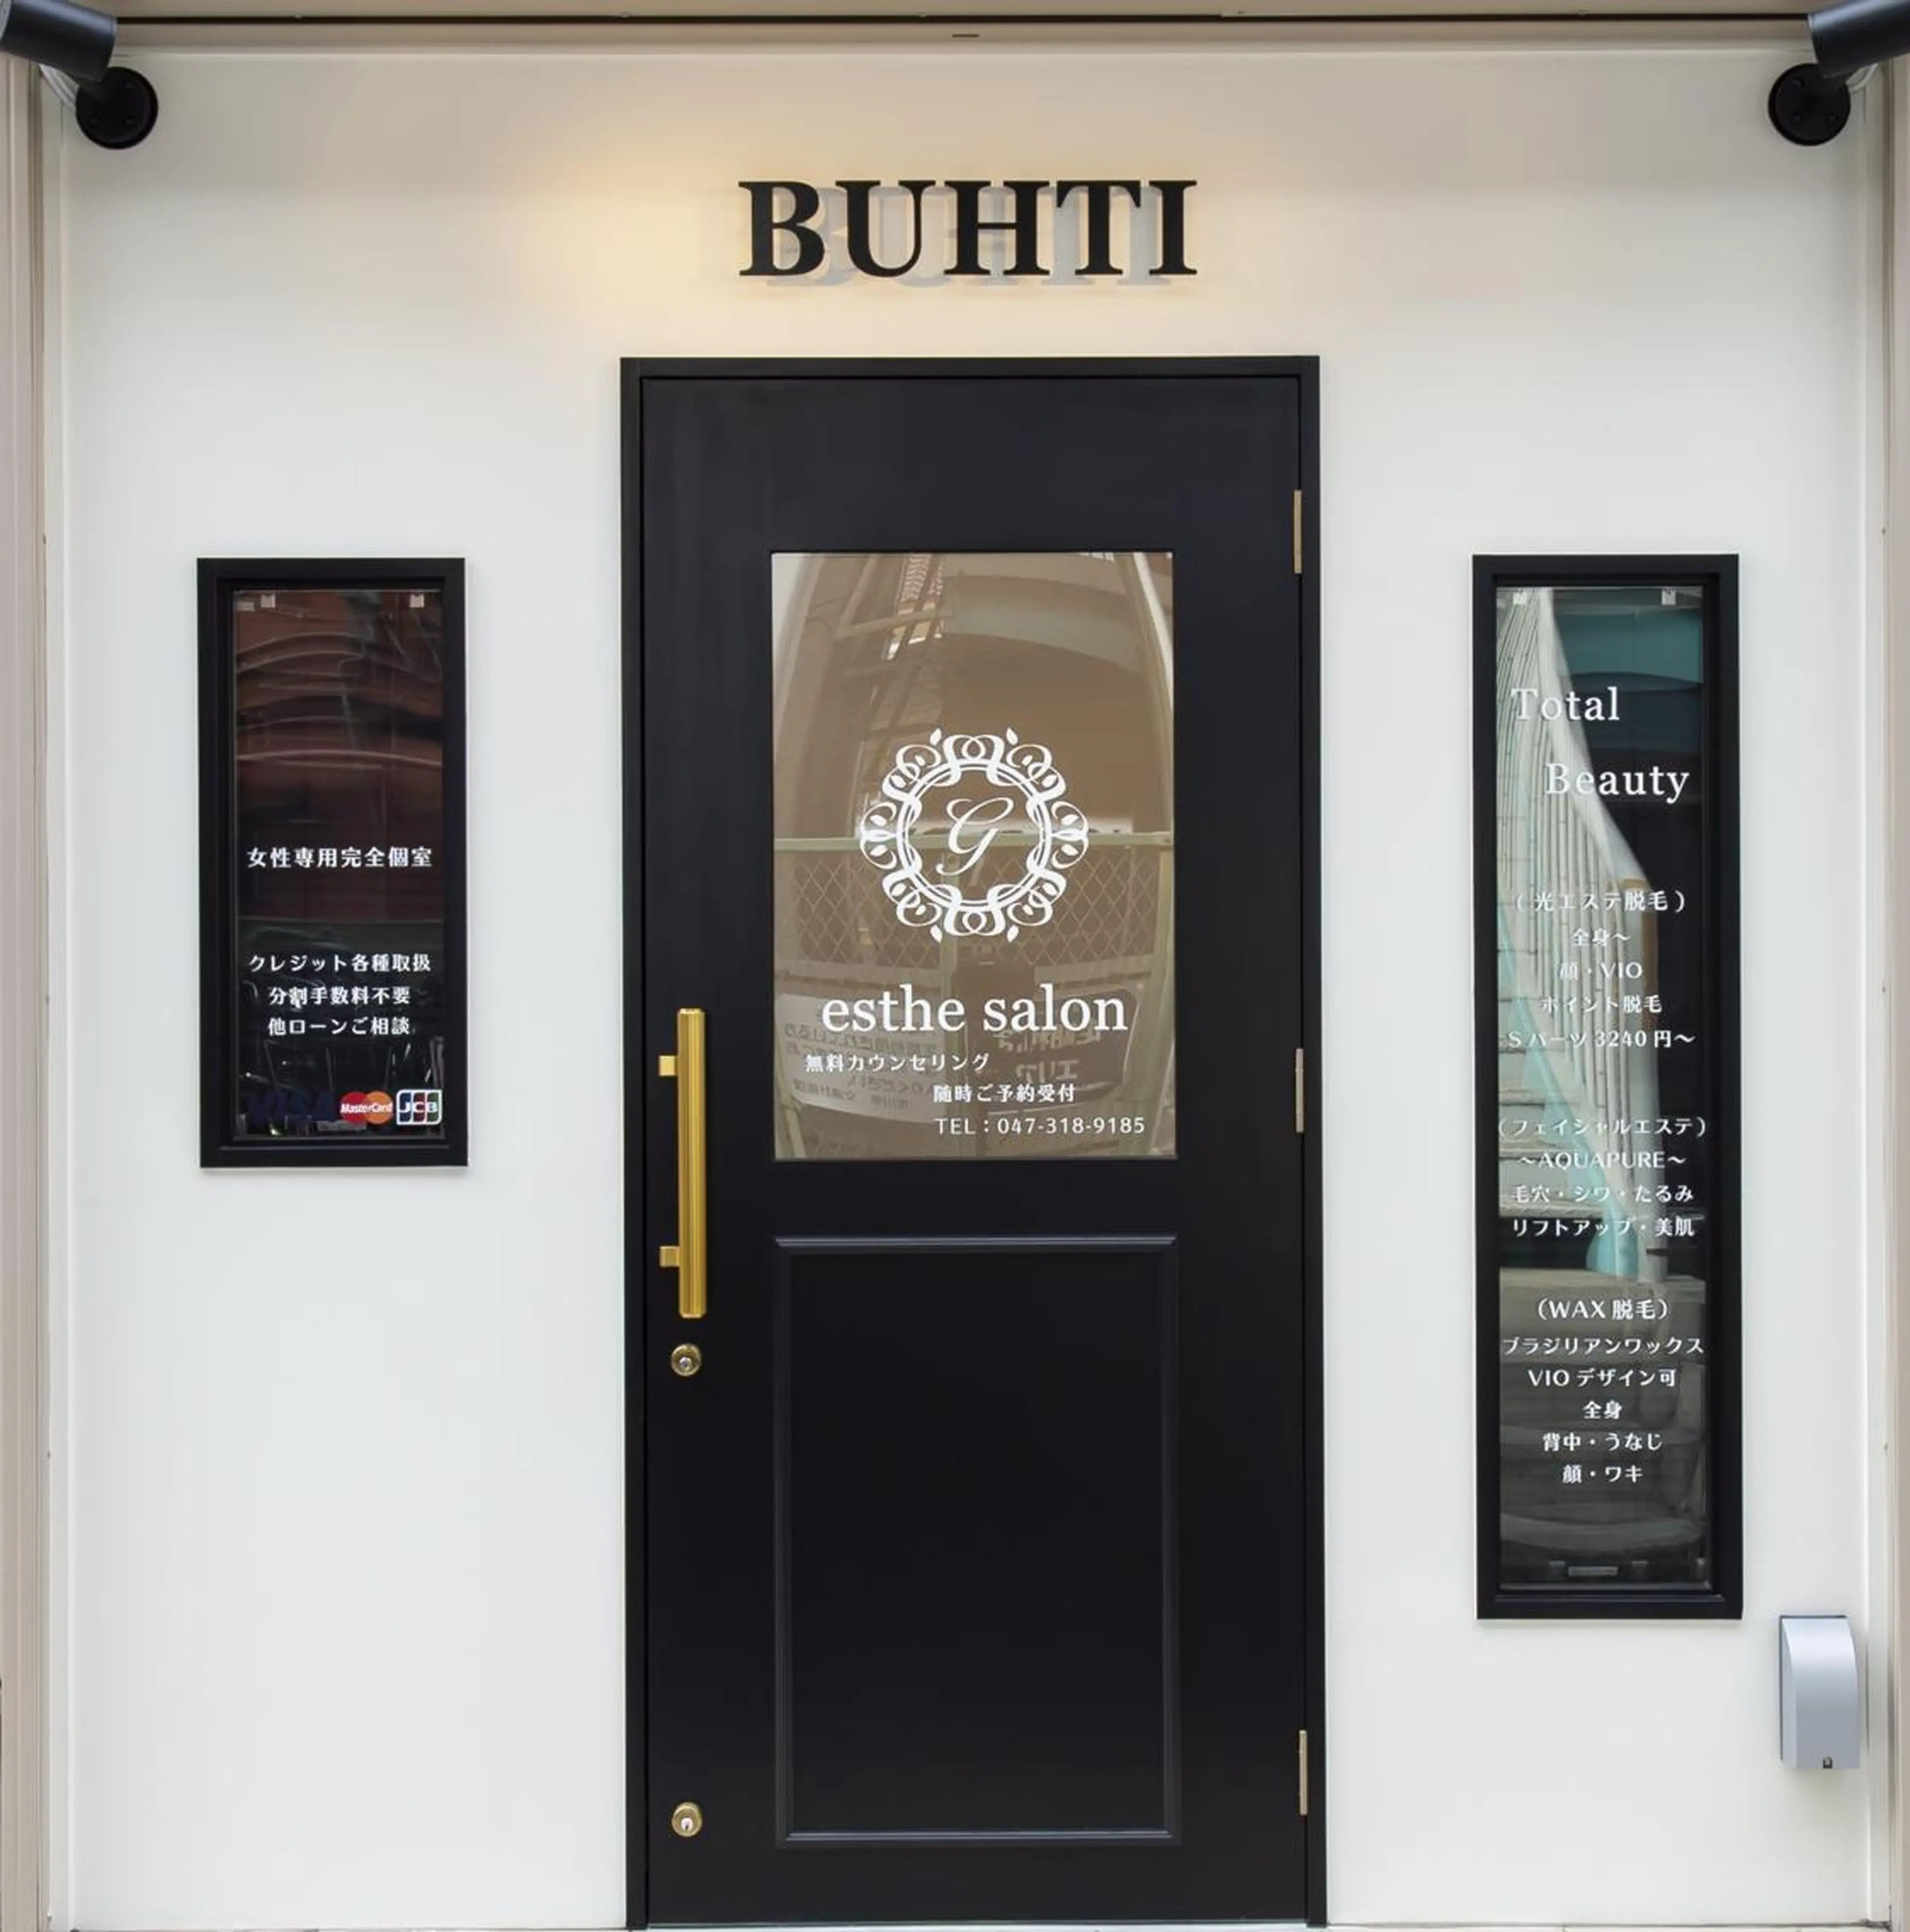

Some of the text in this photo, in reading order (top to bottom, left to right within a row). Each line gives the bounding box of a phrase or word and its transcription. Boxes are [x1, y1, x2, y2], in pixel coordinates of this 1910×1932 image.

[738, 180, 1197, 277] BUHTI
[1511, 686, 1620, 721] Total
[1546, 763, 1690, 804] Beauty
[247, 847, 432, 869] 女性専用完全個室
[249, 954, 431, 972] クレジット各種取扱
[269, 986, 411, 1006] 分割手数料不要
[822, 983, 1128, 1032] esthe salon
[268, 1017, 410, 1036] 他ローンご相談
[804, 1053, 990, 1073] 無料カウンセリング
[933, 1083, 1075, 1102] 随時ご予約受付
[398, 1101, 438, 1113] JCB
[1512, 1185, 1694, 1203] 毛穴・シワ・たるみ
[1502, 1337, 1705, 1354] ブラジリアンワックス
[1583, 1400, 1623, 1419] 全身
[1542, 1433, 1663, 1451] 背中・うなじ
[1562, 1465, 1643, 1483] 顔・ワキ
